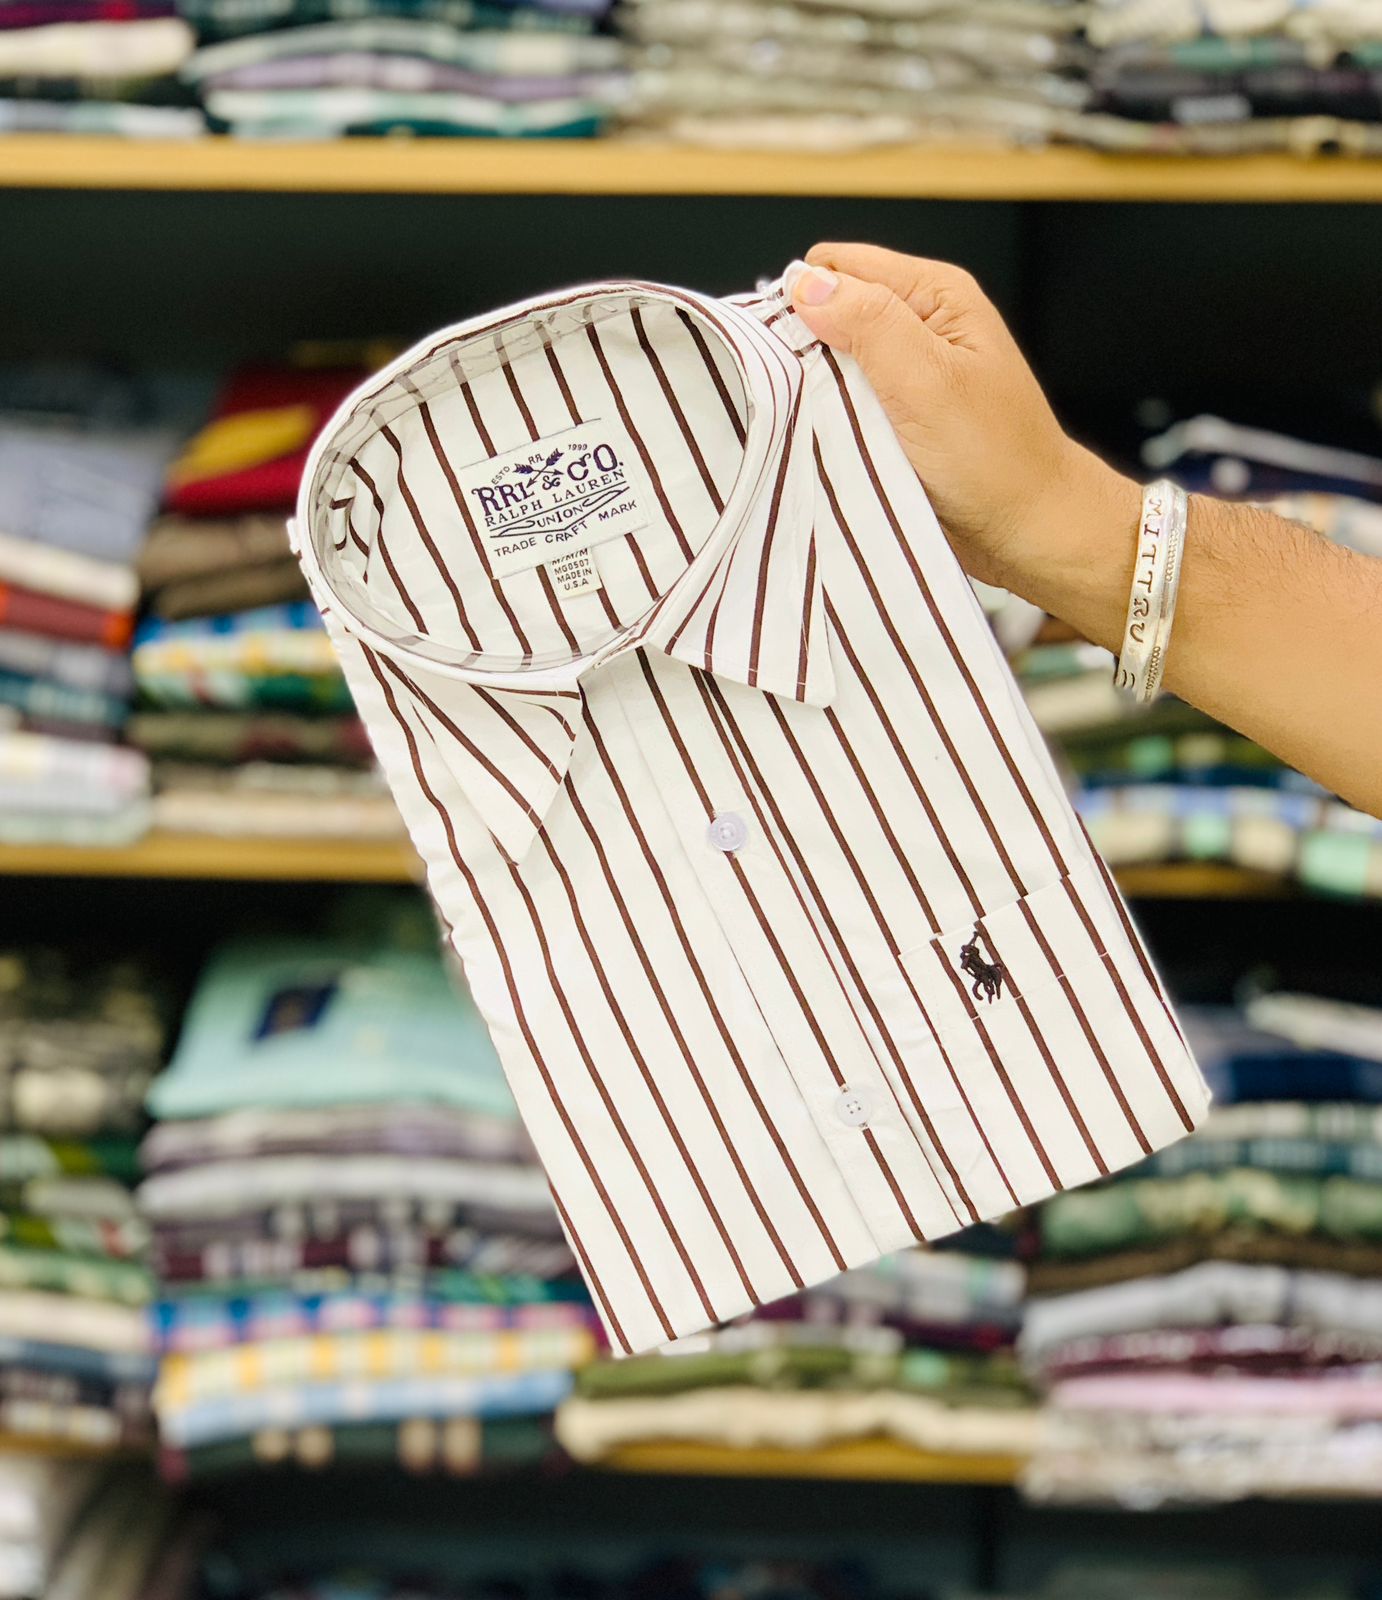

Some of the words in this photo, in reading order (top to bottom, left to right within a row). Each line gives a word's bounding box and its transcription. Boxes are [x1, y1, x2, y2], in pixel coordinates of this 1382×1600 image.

[471, 481, 536, 517] RRL
[541, 474, 562, 491] &
[566, 443, 625, 481] CO.
[484, 499, 544, 528] RALPH
[552, 468, 625, 504] LAUREN
[494, 537, 537, 557] TRADE
[544, 520, 589, 544] CRAFT
[598, 500, 637, 521] MARK
[536, 503, 584, 528] UNION
[556, 569, 582, 584] MADE
[582, 567, 593, 577] IN
